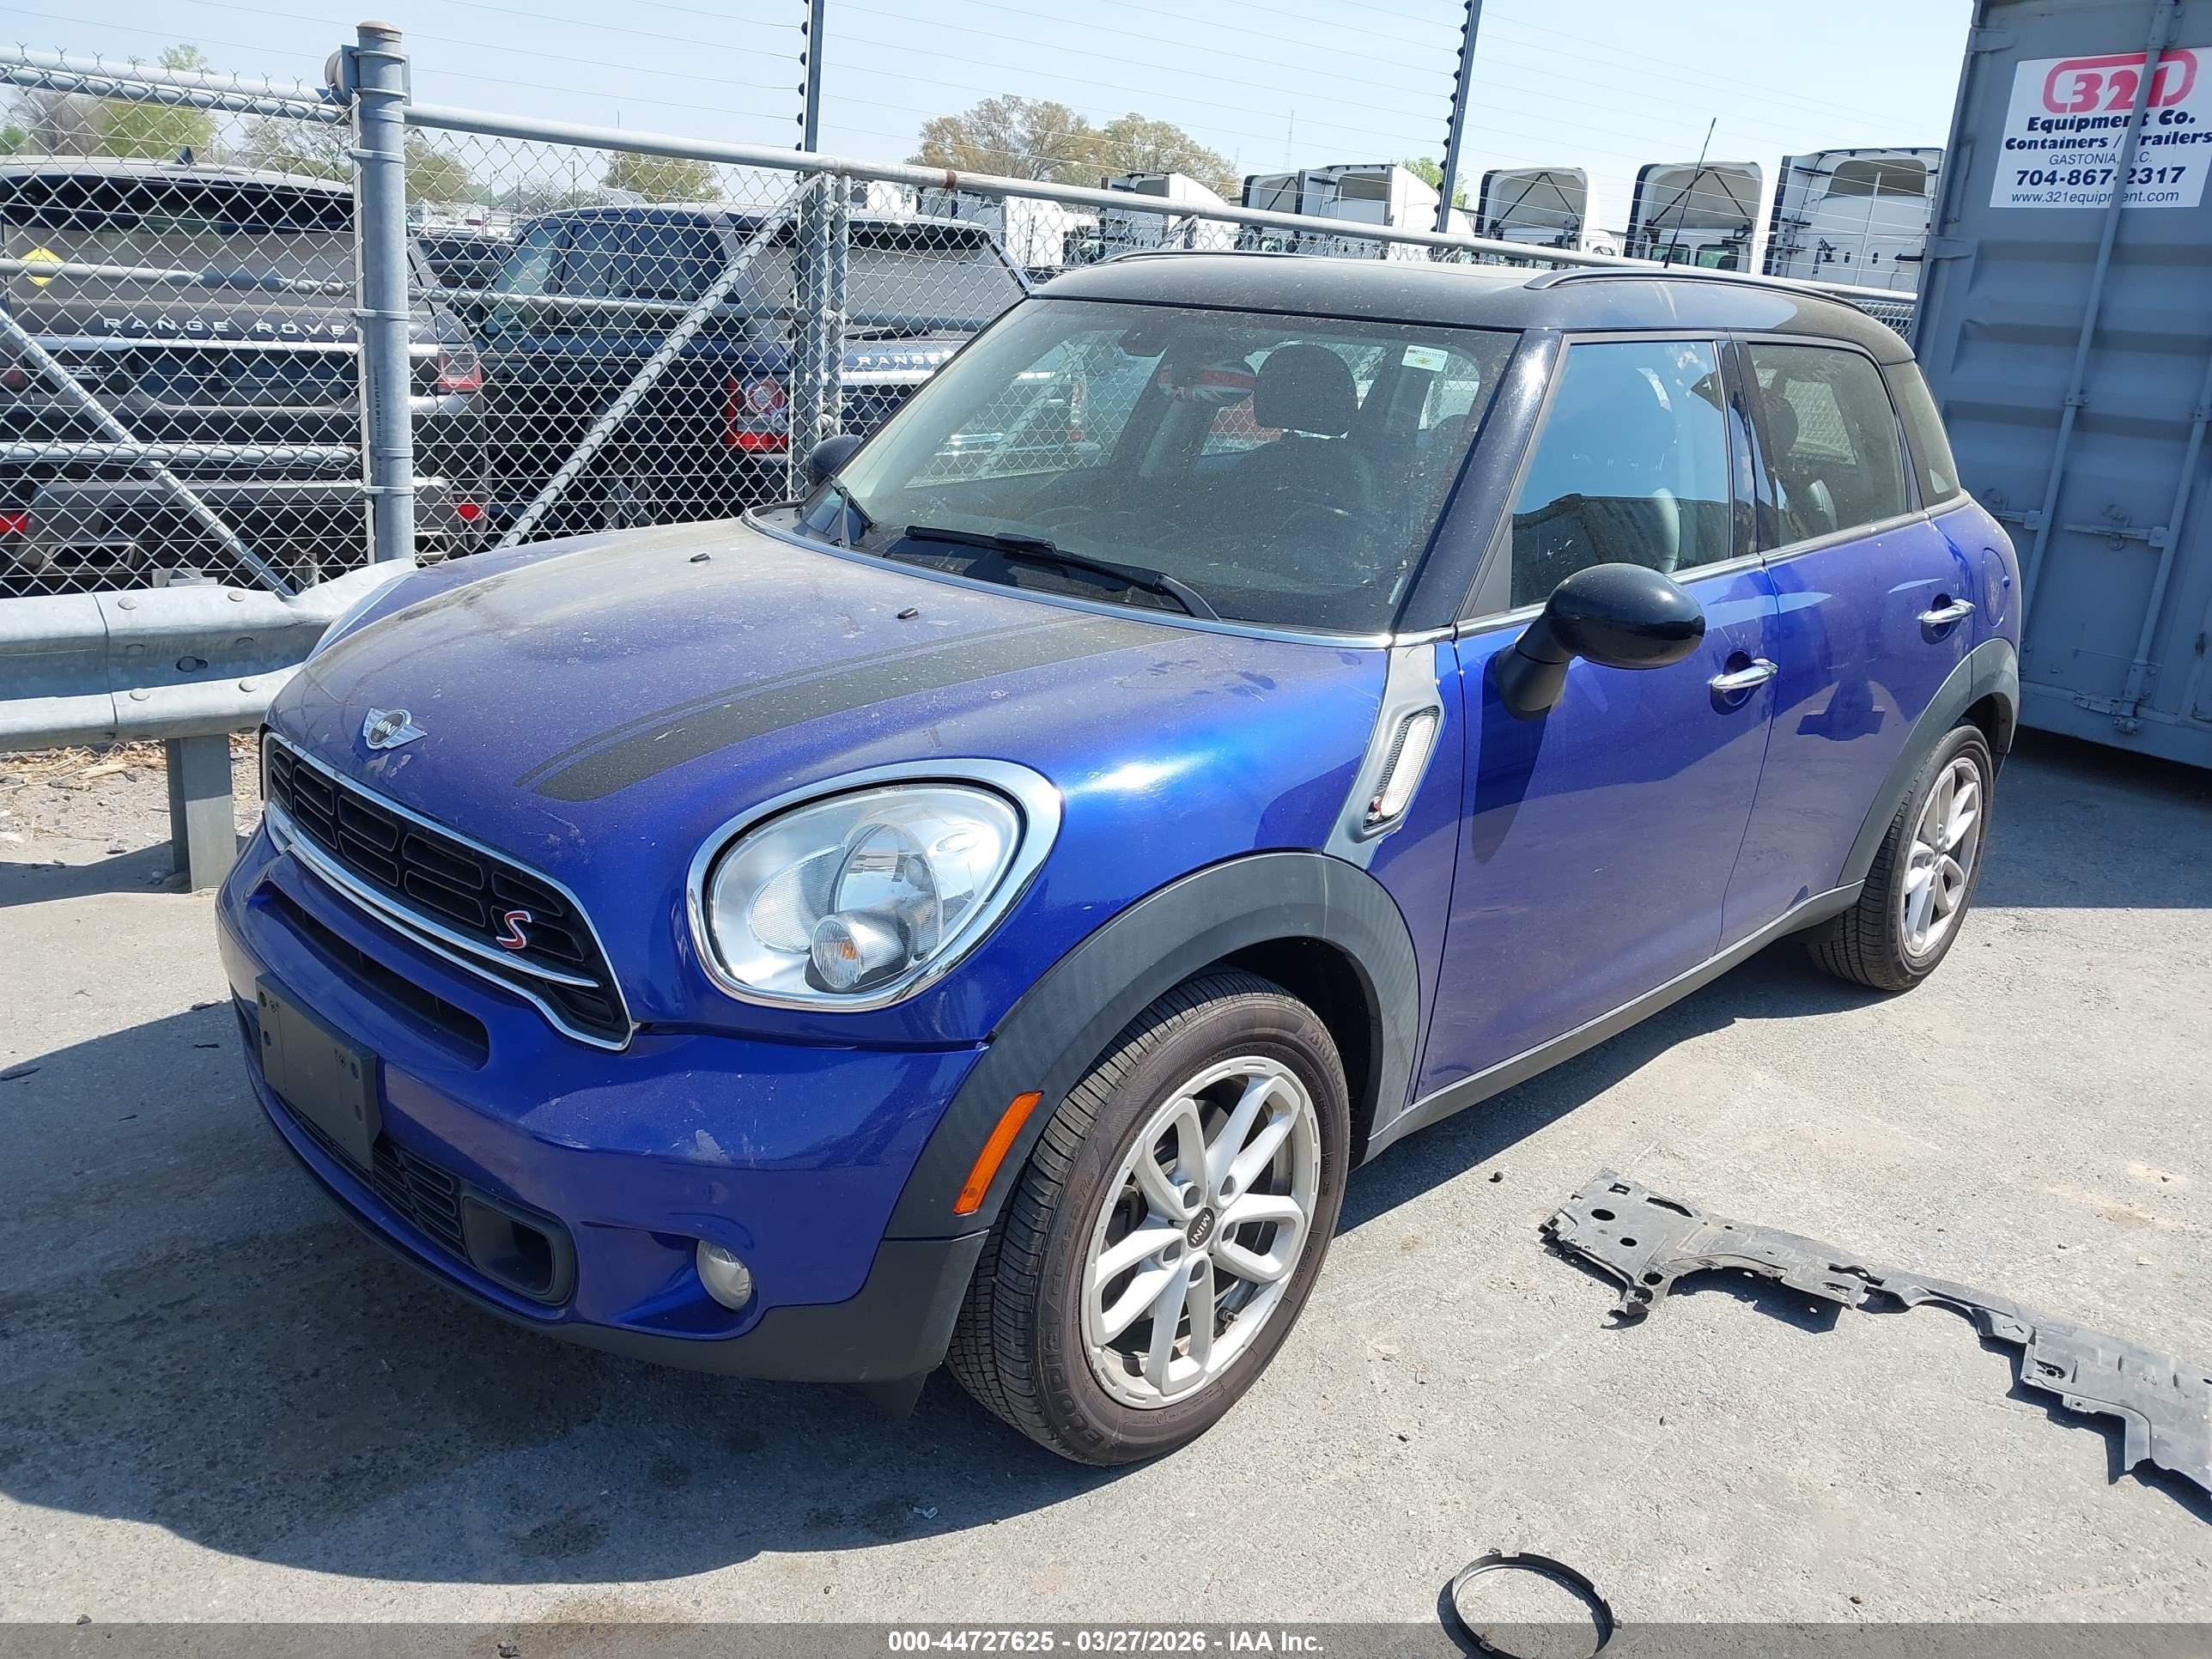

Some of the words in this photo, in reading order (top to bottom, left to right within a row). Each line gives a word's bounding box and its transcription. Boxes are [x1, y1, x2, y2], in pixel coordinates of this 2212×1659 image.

[2068, 66, 2170, 113] 321
[2159, 109, 2196, 125] Co.
[2005, 135, 2108, 151] Containers
[2137, 131, 2212, 147] railers
[2049, 152, 2120, 166] GASTONIA,
[2016, 166, 2186, 186] 704-867-2317
[103, 319, 228, 332] RANGE
[257, 320, 358, 336] ROVE
[858, 356, 939, 366] RANGE
[495, 910, 532, 949] S
[1190, 1213, 1211, 1244] MINI
